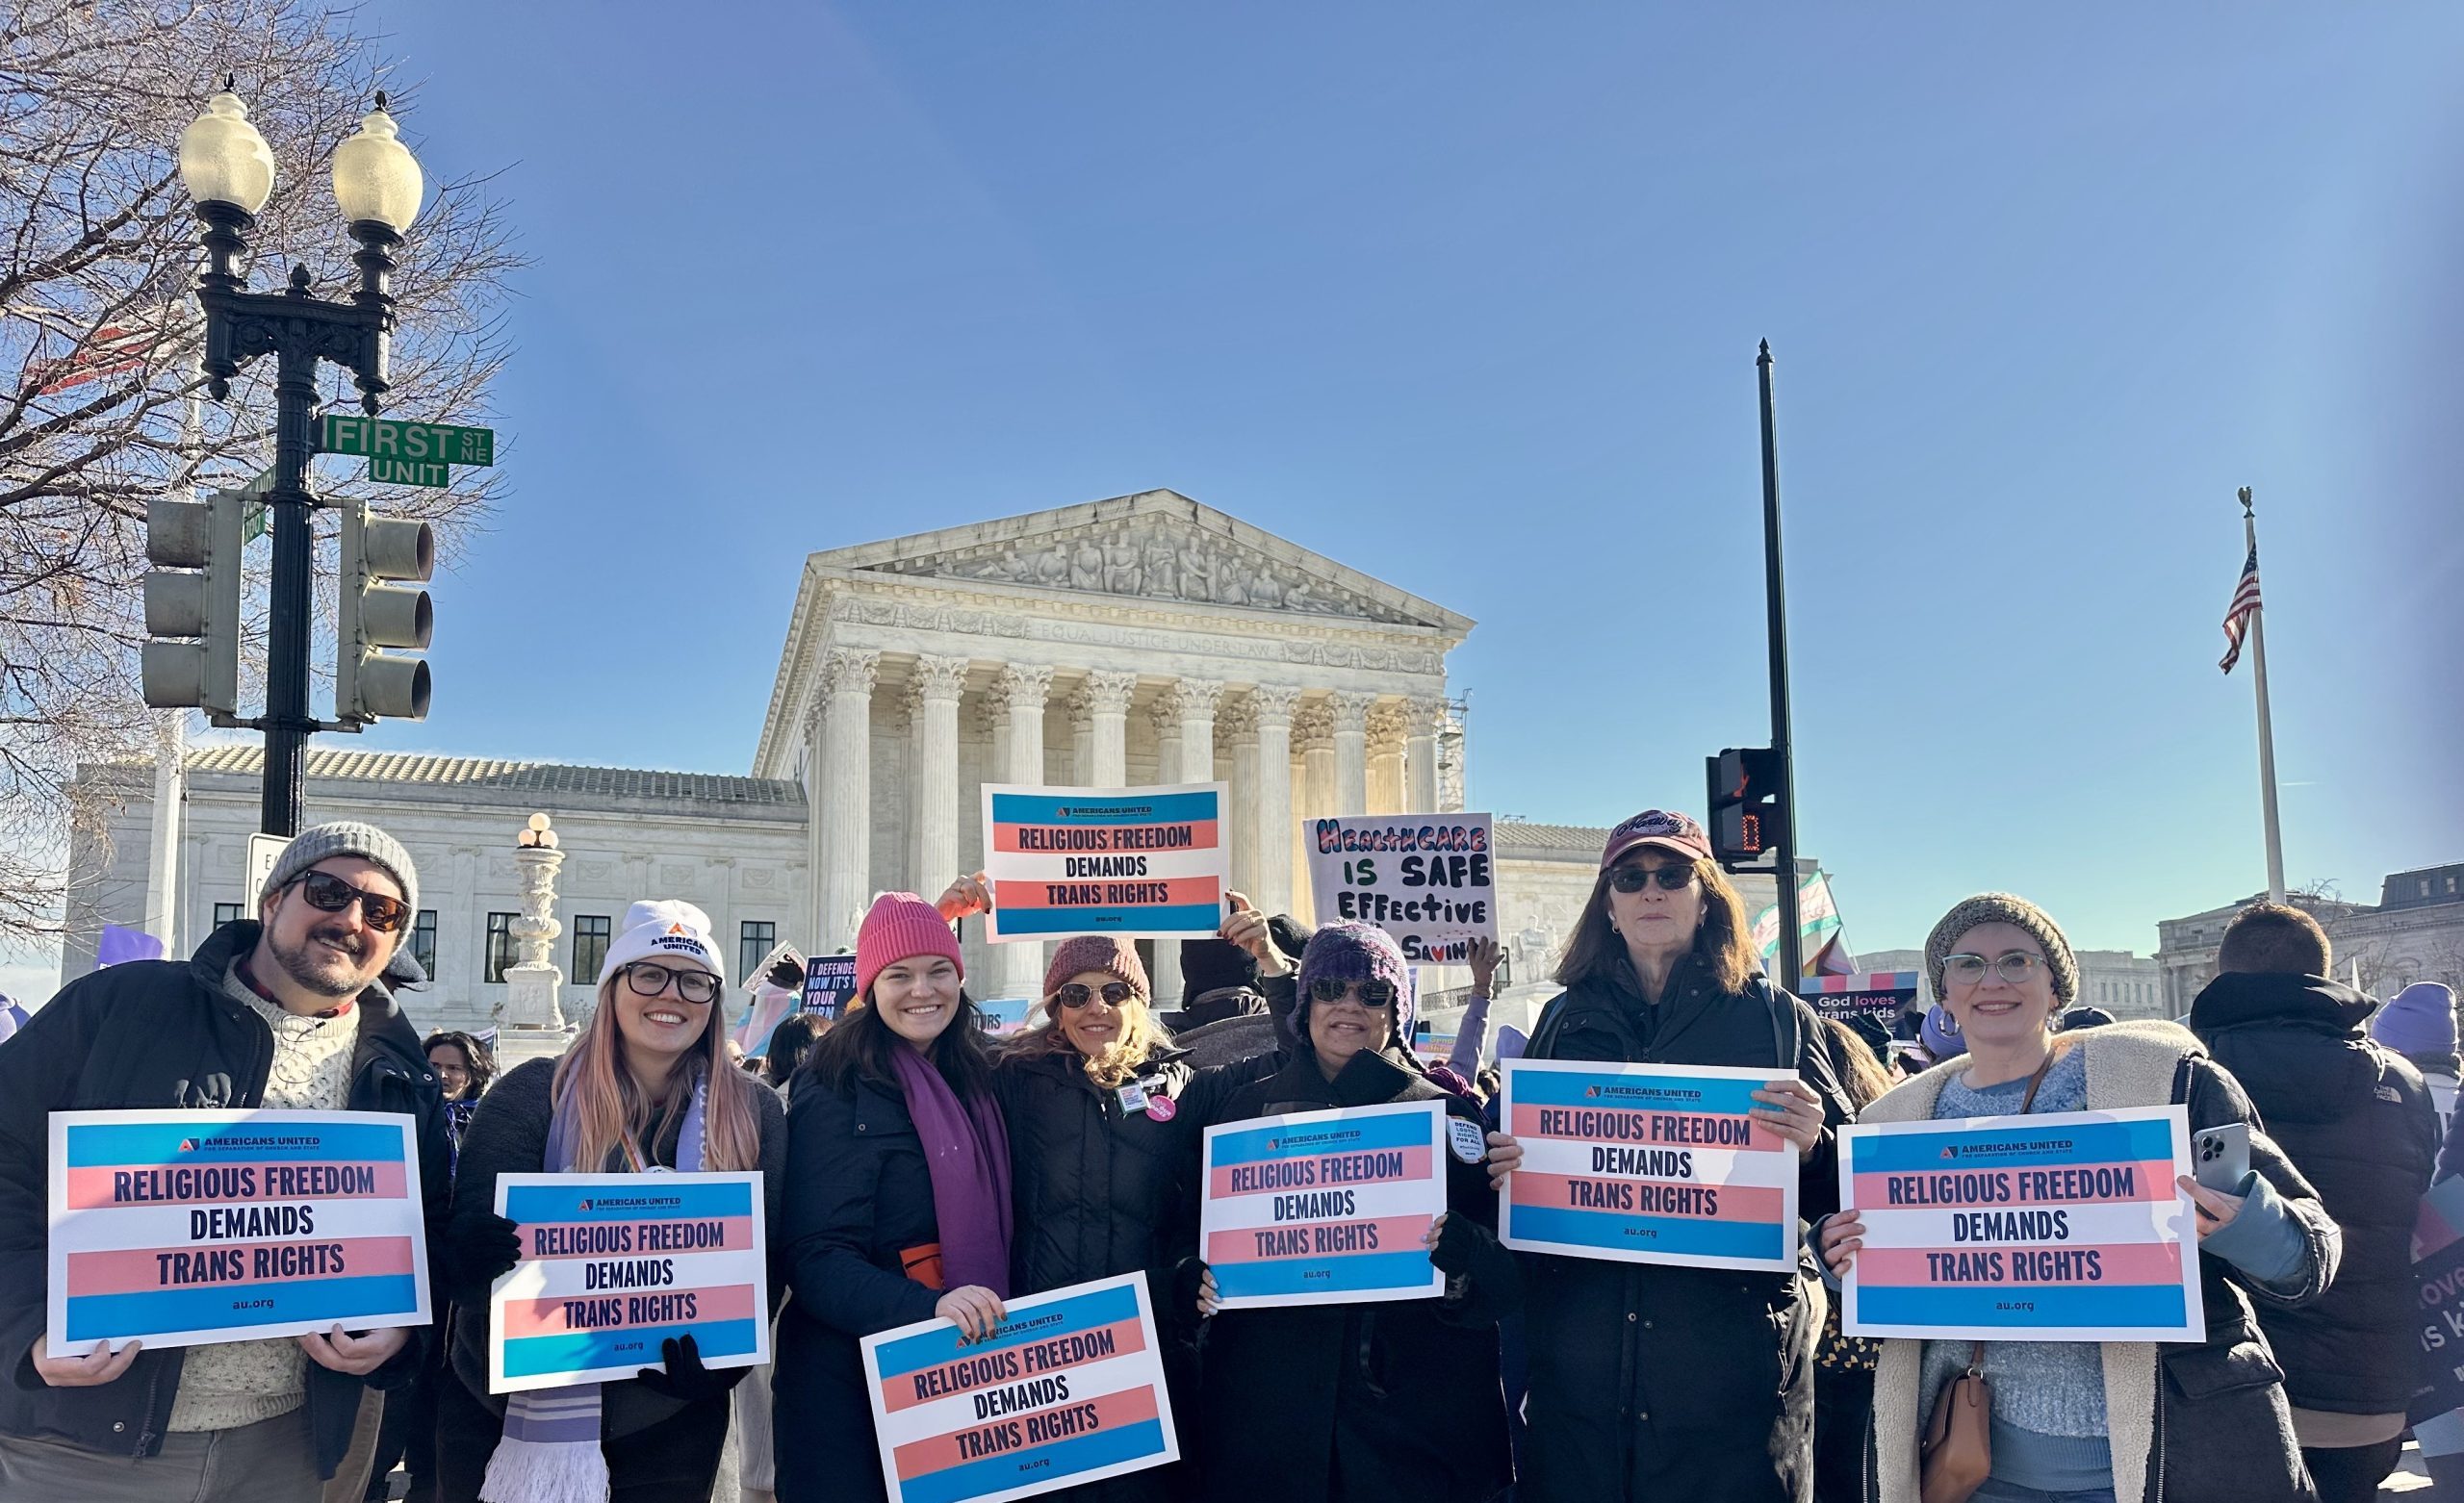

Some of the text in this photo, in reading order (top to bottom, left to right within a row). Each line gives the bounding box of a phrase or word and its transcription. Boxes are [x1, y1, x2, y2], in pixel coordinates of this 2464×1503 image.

[336, 420, 454, 459] FIRST
[461, 432, 485, 447] ST
[461, 447, 487, 463] NE
[372, 460, 444, 485] UNIT
[1041, 624, 1271, 658] EQUAL JUSTICE UNDER LAW
[1018, 825, 1193, 851] RELIGIOUS FREEDOM
[1065, 855, 1147, 878] DEMANDS
[1344, 853, 1491, 888] IS SAFE
[1046, 882, 1168, 905] TRANS RIGHTS
[651, 936, 709, 955] AMERICANS
[663, 943, 702, 955] UNITED
[810, 963, 815, 976] I
[808, 977, 831, 989] NOW
[832, 975, 850, 989] IT'S
[806, 991, 836, 1006] YOUR
[1817, 995, 1896, 1007] God loves
[1604, 1086, 1702, 1098] AMERICANS UNITED
[1282, 1134, 1329, 1145] AMERICANS
[1330, 1130, 1361, 1140] UNITED
[1454, 1122, 1477, 1131] DEFEND
[1540, 1108, 1751, 1146] RELIGIOUS FREEDOM
[204, 1136, 321, 1146] AMERICANS UNITED
[1962, 1140, 2073, 1154] AMERICANS UNITED
[1231, 1151, 1403, 1192] RELIGIOUS FREEDOM
[1592, 1147, 1692, 1178] DEMANDS
[115, 1165, 374, 1202] RELIGIOUS FREEDOM
[1887, 1167, 2135, 1205] RELIGIOUS FREEDOM
[597, 1198, 647, 1207] AMERICANS
[1273, 1189, 1356, 1222] DEMANDS
[1568, 1180, 1718, 1216] TRANS RIGHTS
[191, 1205, 314, 1240] DEMANDS
[1624, 1228, 1657, 1238] au.org
[1953, 1210, 2069, 1241] DEMANDS
[535, 1221, 724, 1256] RELIGIOUS FREEDOM
[1254, 1223, 1378, 1258] TRANS RIGHTS
[157, 1243, 345, 1286] TRANS RIGHTS
[585, 1259, 674, 1290] DEMANDS
[1303, 1269, 1331, 1279] au.org
[1926, 1250, 2102, 1282] TRANS RIGHTS
[232, 1298, 274, 1311] au.org
[563, 1292, 698, 1329] TRANS RIGHTS
[1995, 1300, 2035, 1312] au.org
[1029, 1313, 1064, 1328] UNITED
[614, 1341, 644, 1352] au.org
[913, 1329, 1116, 1400] RELIGIOUS FREEDOM
[973, 1374, 1070, 1420] DEMANDS
[955, 1403, 1099, 1460] TRANS RIGHTS
[1018, 1458, 1050, 1472] au.org
